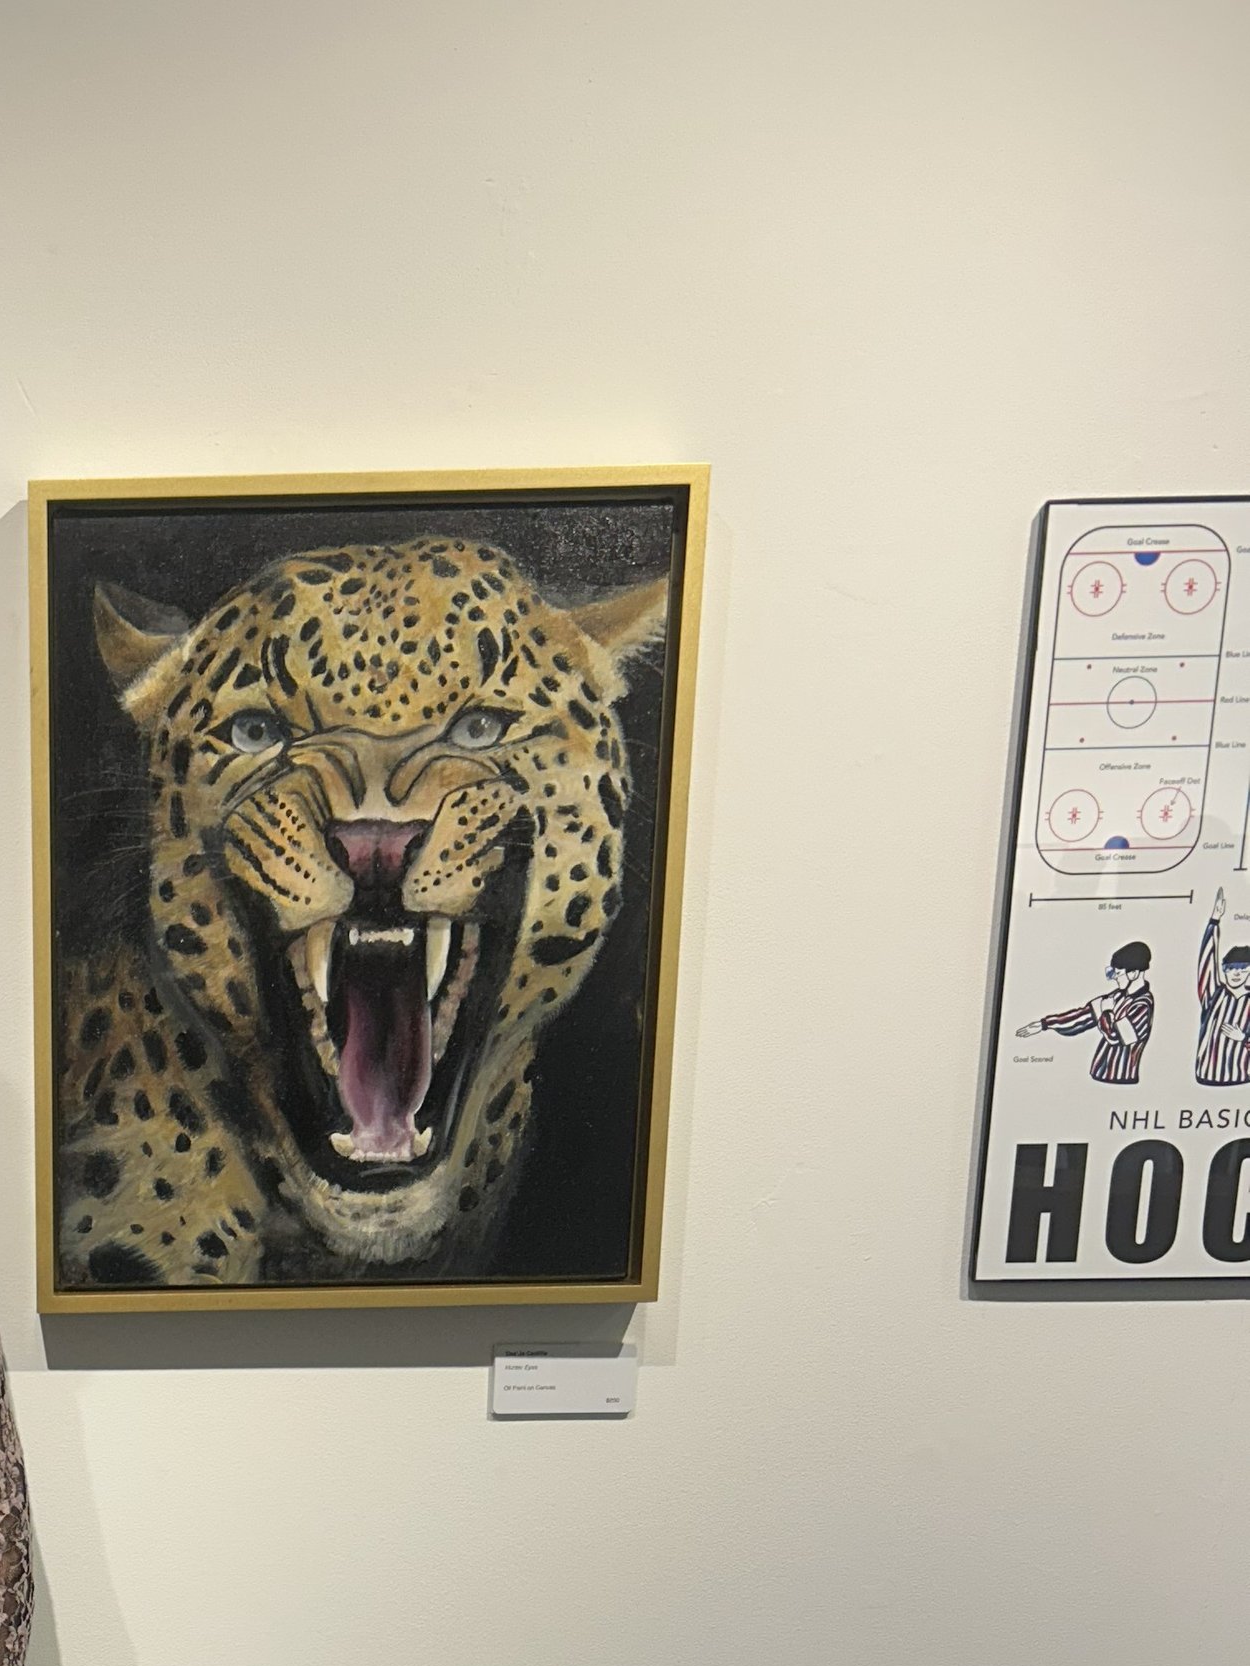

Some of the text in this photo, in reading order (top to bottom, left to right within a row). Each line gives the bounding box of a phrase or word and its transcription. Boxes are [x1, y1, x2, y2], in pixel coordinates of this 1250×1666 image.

[1127, 537, 1170, 546] Goal Crease
[1112, 632, 1165, 641] Defensive Zone
[1226, 650, 1240, 658] Blue
[1220, 696, 1234, 704] Red
[1215, 741, 1230, 749] Blue
[1099, 762, 1151, 771] Offensive Zone
[1159, 777, 1201, 785] Faceoff Dot
[1203, 842, 1219, 850] Goal
[1113, 853, 1136, 861] Crease
[1013, 1055, 1054, 1063] Goal Scored
[1109, 1110, 1166, 1130] NHL
